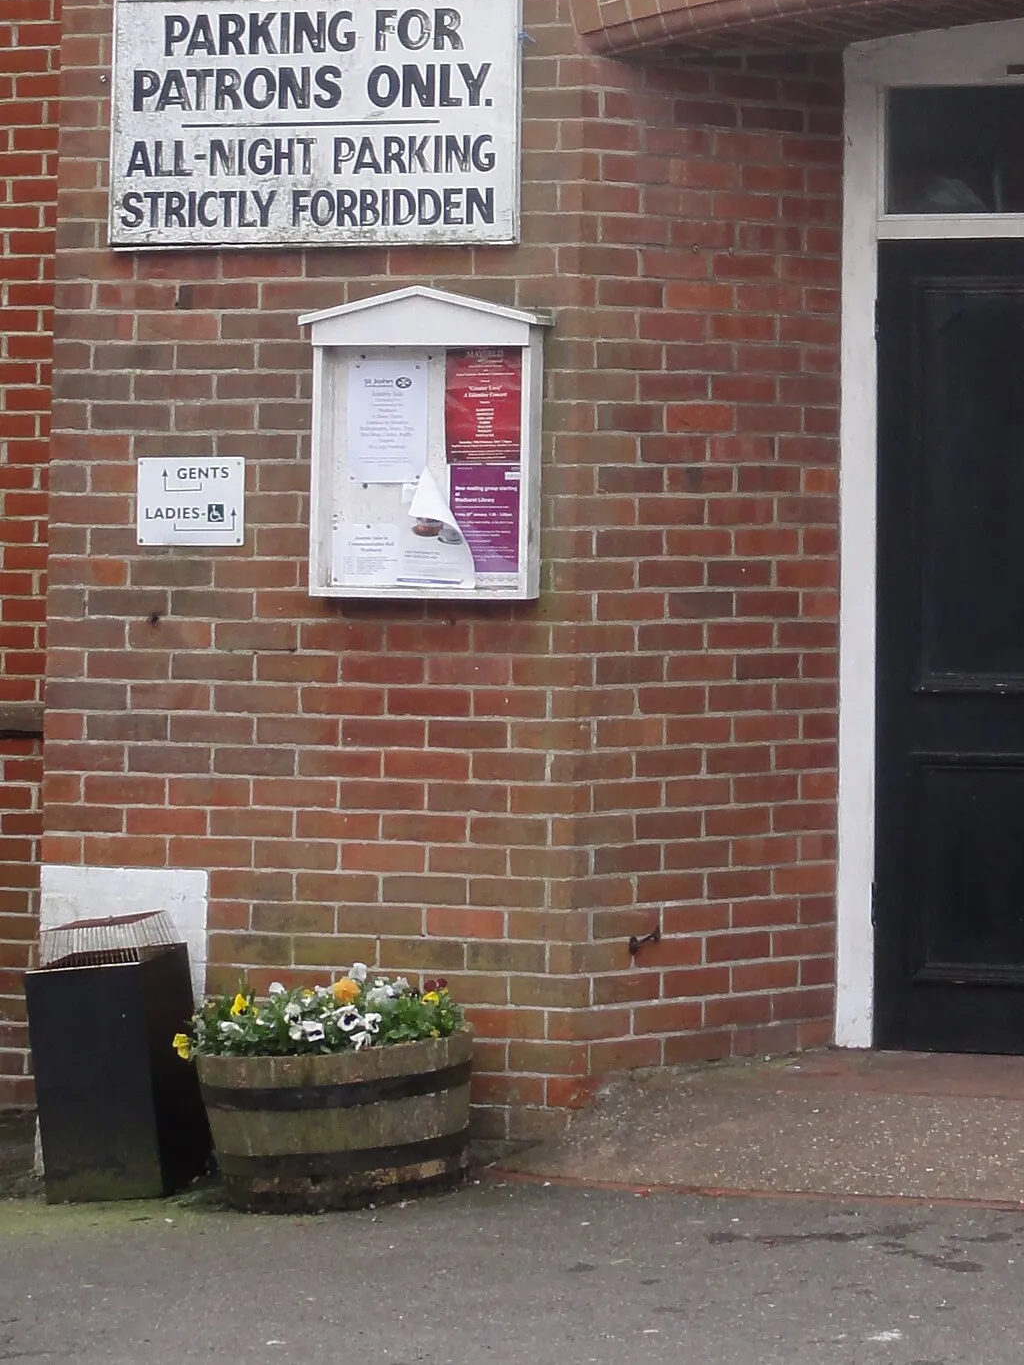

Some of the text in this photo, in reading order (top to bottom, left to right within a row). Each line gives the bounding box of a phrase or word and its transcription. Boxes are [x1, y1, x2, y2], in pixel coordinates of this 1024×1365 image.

[164, 7, 465, 56] PARKING FOR
[132, 62, 493, 111] PATRONS ONLY.
[126, 133, 496, 177] ALL-NIGHT PARKING
[120, 187, 495, 229] STRICTLY FORBIDDEN
[177, 467, 229, 480] GENTS
